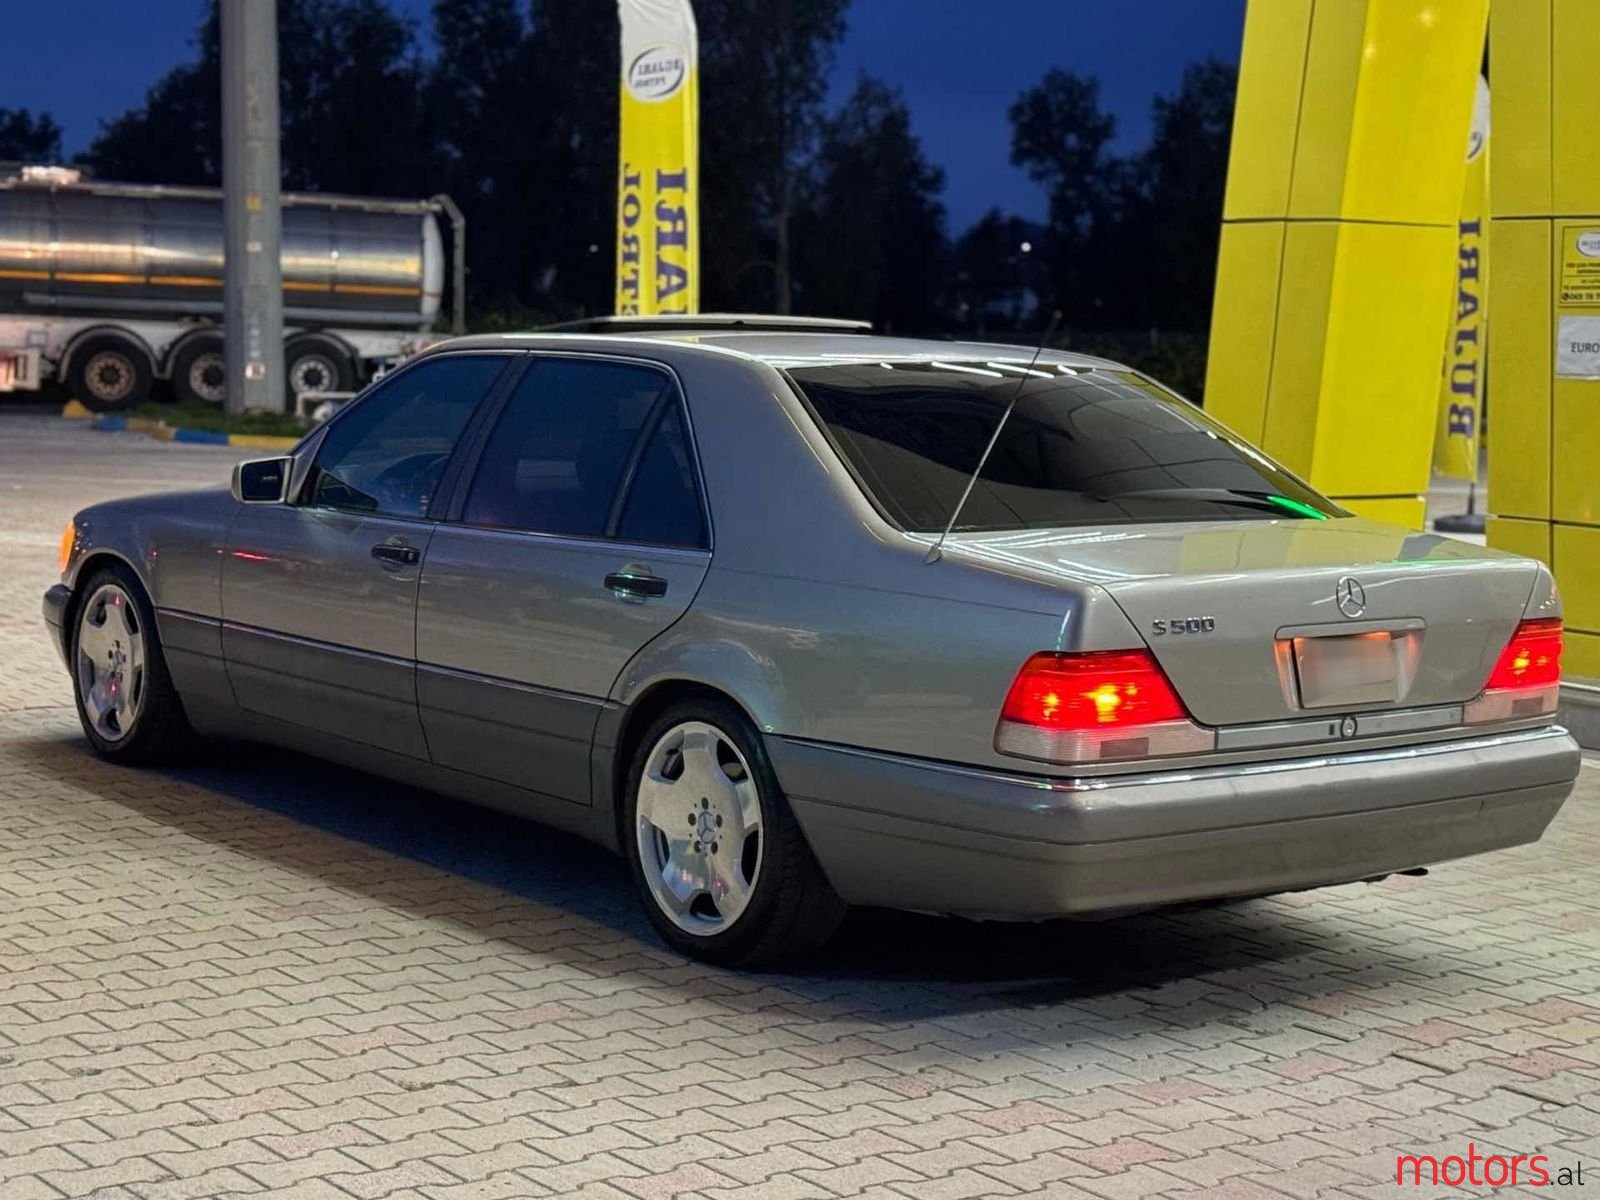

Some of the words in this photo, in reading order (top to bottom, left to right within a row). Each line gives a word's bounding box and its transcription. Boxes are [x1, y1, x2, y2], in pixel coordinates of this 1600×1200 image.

[1571, 342, 1600, 353] EURO
[1152, 620, 1167, 635] S
[1170, 616, 1215, 634] 500
